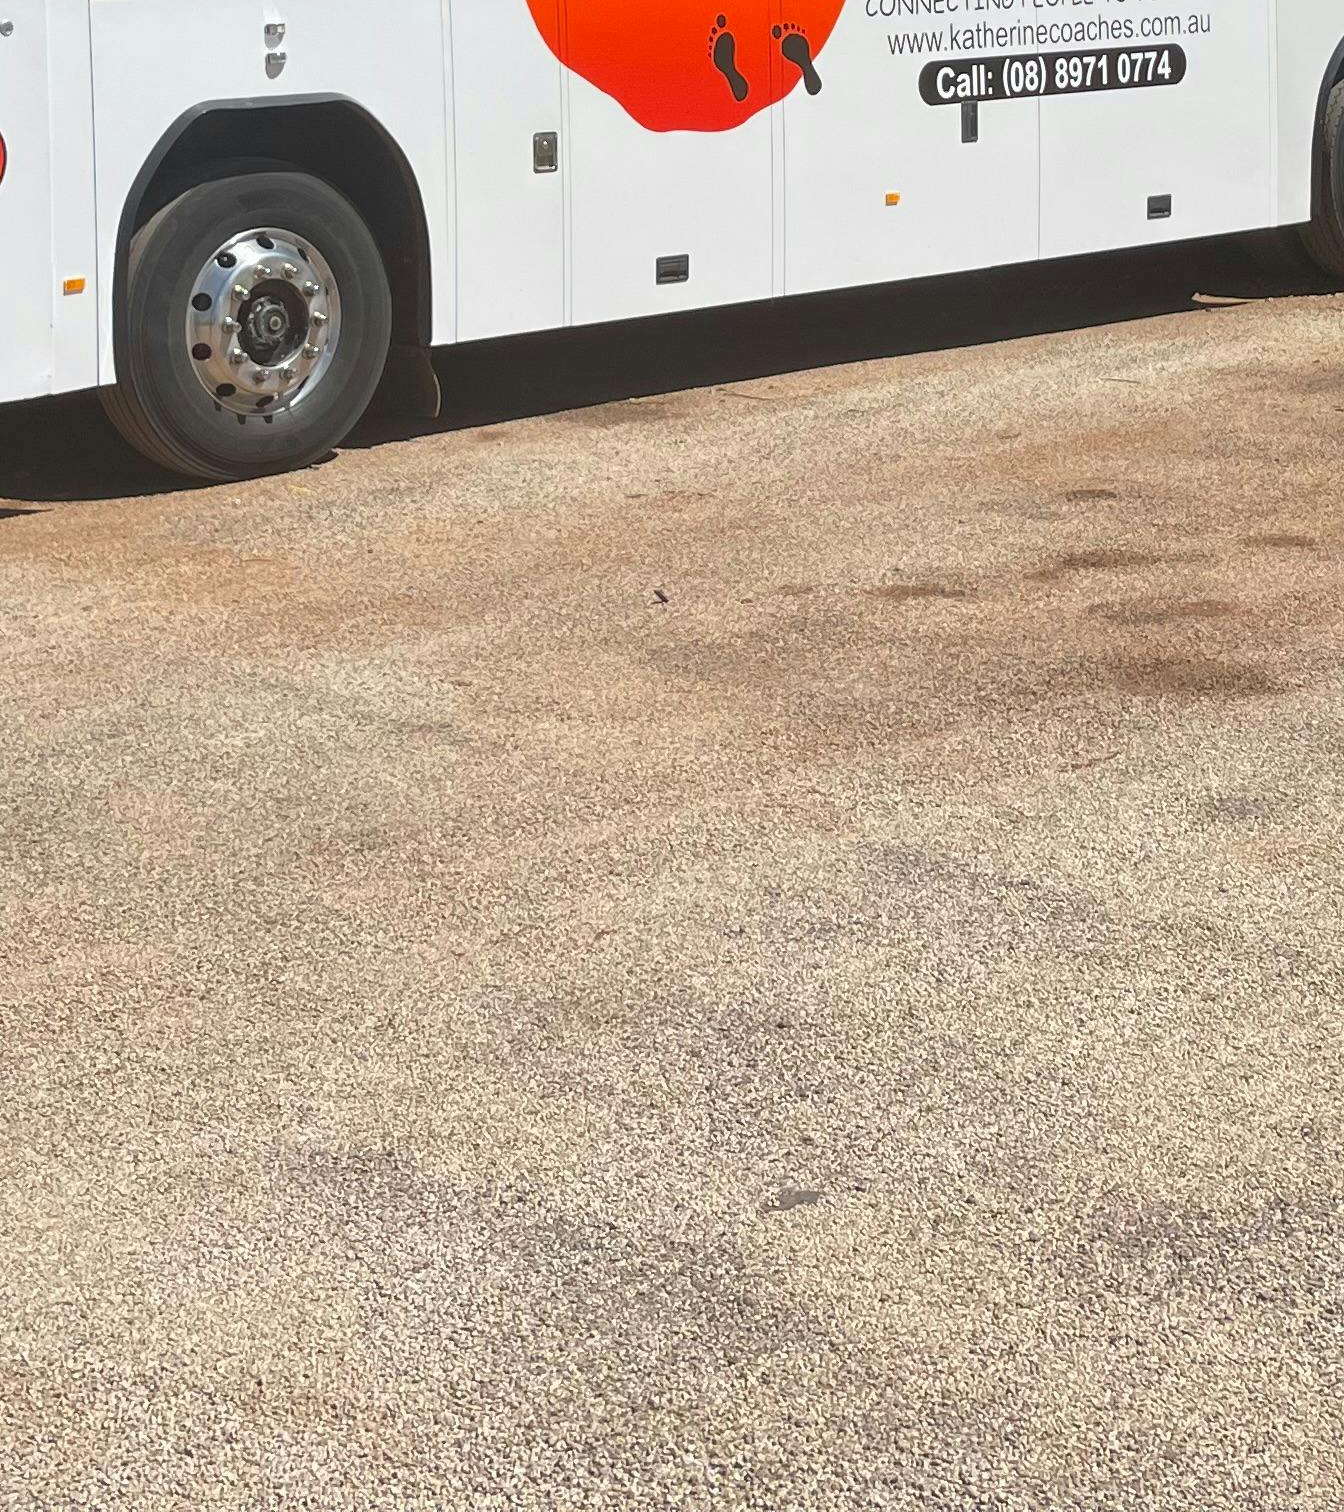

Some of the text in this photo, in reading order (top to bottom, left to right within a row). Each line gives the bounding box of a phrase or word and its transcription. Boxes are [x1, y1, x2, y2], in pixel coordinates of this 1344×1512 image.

[887, 14, 1211, 55] www.katherinecoaches.com.au
[936, 49, 1172, 99] Call: (08) 8971 0774
